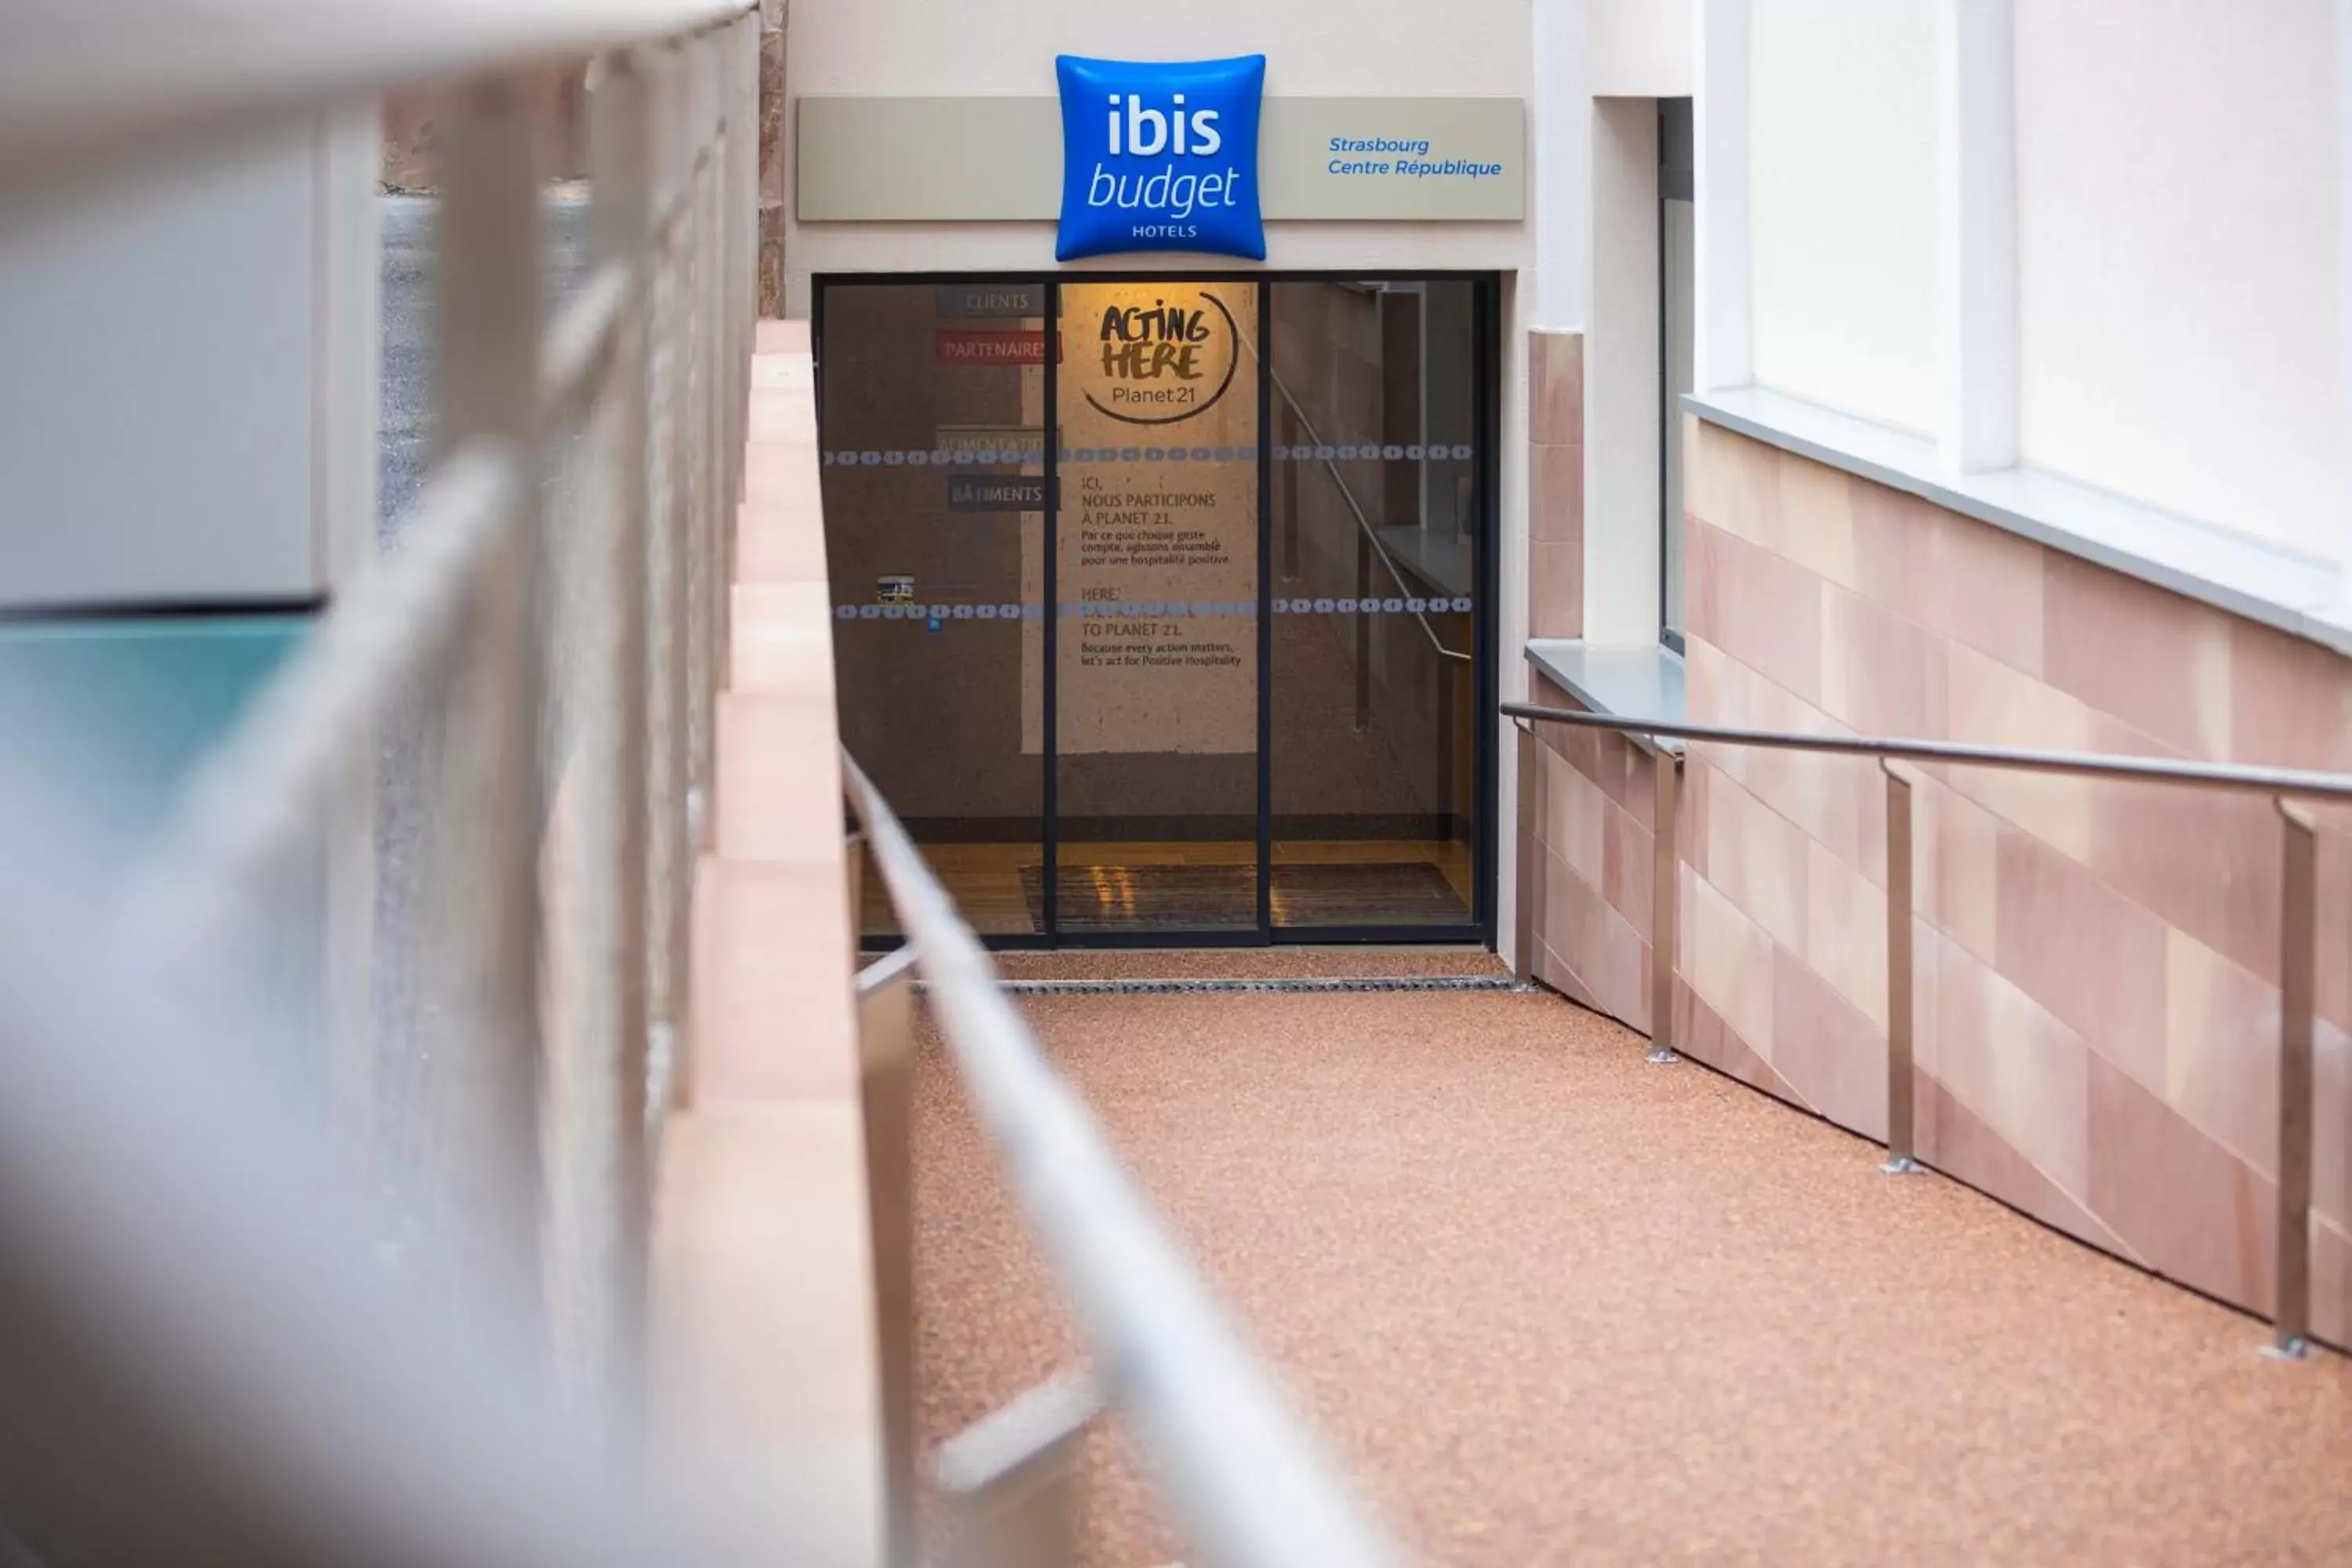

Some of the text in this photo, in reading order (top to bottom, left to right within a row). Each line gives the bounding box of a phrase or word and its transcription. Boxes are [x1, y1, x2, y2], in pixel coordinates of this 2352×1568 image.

[1109, 94, 1221, 156] ibis
[1329, 138, 1430, 155] Strasbourg
[1328, 158, 1502, 179] Centre République
[1087, 162, 1240, 219] budget
[1132, 225, 1198, 238] HOTELS
[966, 293, 1029, 309] CLIENTS
[1100, 340, 1203, 381] HERE
[952, 483, 1043, 503] BÂTIMENTS
[1082, 492, 1217, 508] NOUS PARTICIPONS
[1095, 511, 1150, 525] PLANET
[1081, 530, 1098, 540] Par
[1116, 532, 1136, 543] que
[1137, 530, 1175, 543] chaque
[1177, 532, 1205, 543] geste
[1126, 543, 1170, 554] agissons
[1171, 541, 1221, 551] ensemble
[1080, 557, 1105, 568] pour
[1109, 557, 1129, 565] une
[1131, 554, 1185, 568] hospitalité
[1082, 623, 1103, 637] TO
[1106, 623, 1160, 637] PLANET
[1081, 643, 1123, 654] Because
[1125, 645, 1153, 656] every
[1156, 643, 1188, 654] action
[1105, 657, 1123, 666] act
[1124, 655, 1141, 666] for
[1142, 655, 1183, 667] Positive
[1185, 655, 1242, 669] Hospitality
